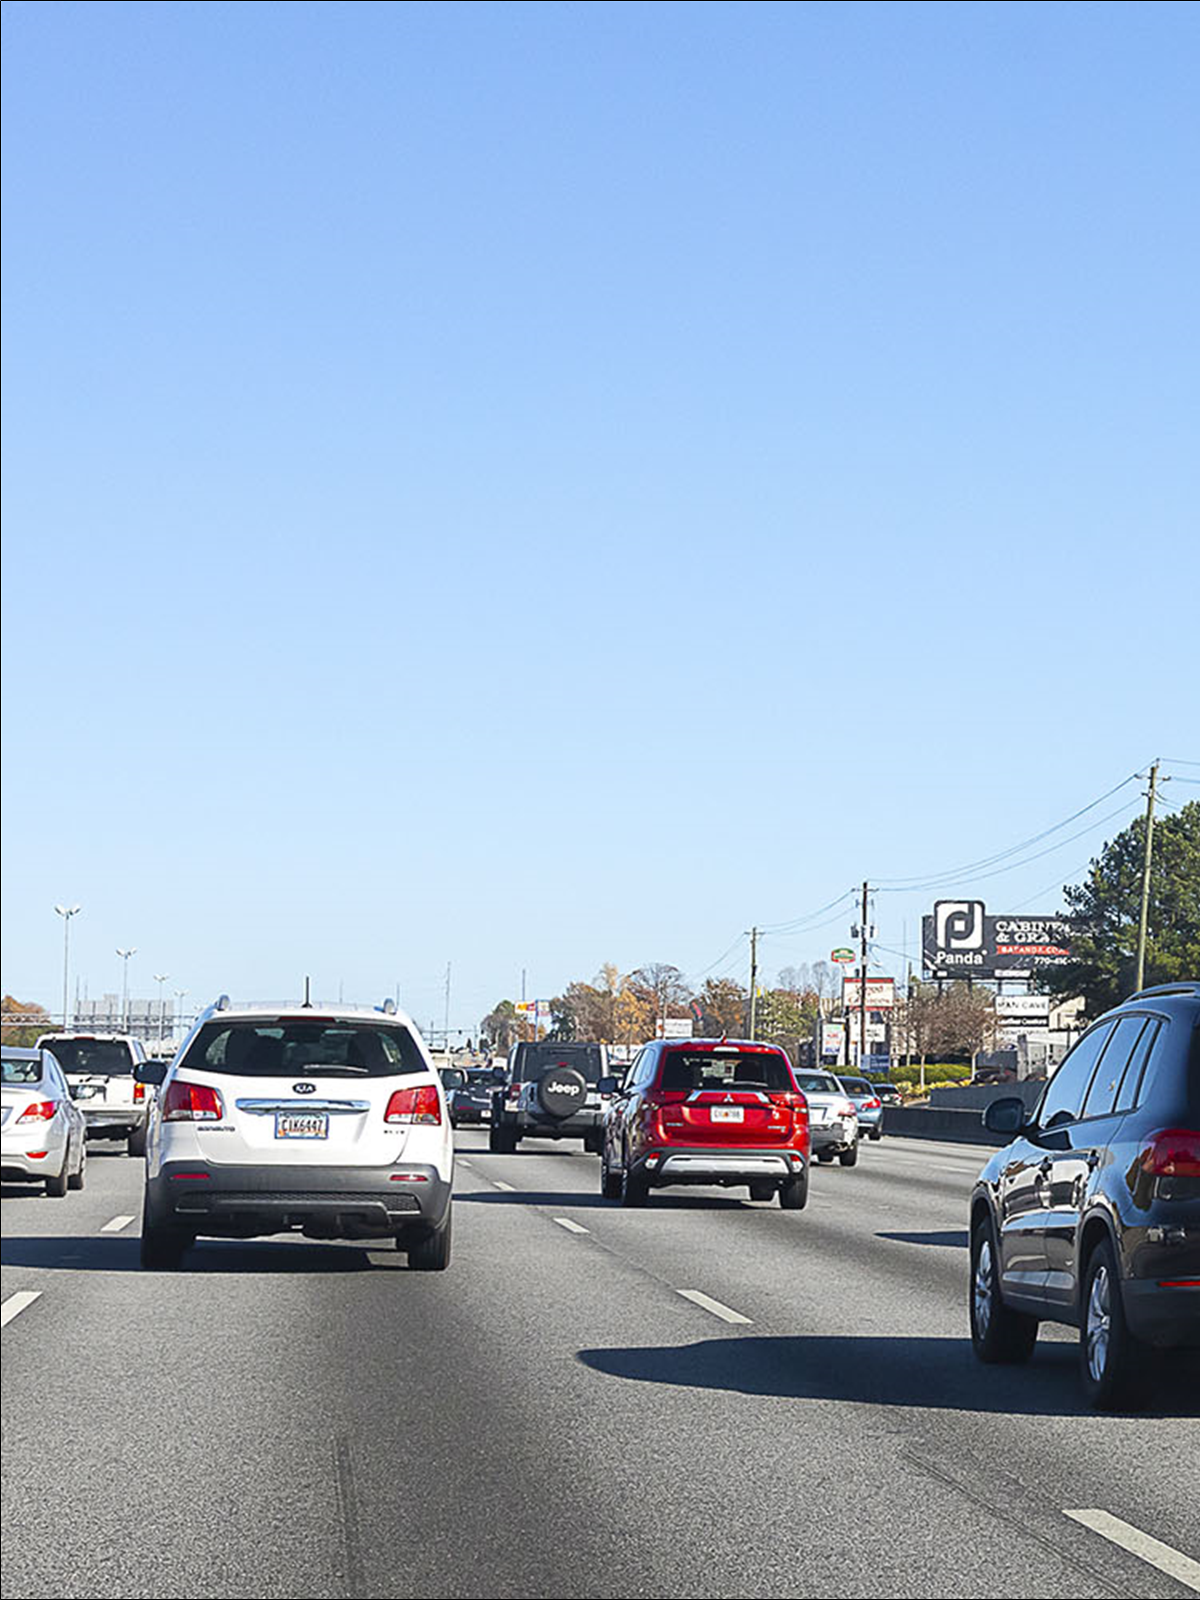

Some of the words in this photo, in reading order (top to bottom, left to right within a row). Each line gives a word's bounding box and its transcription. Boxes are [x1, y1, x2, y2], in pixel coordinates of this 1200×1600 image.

[995, 933, 1010, 942] &
[936, 952, 983, 965] Panda
[548, 1081, 580, 1096] Jeep
